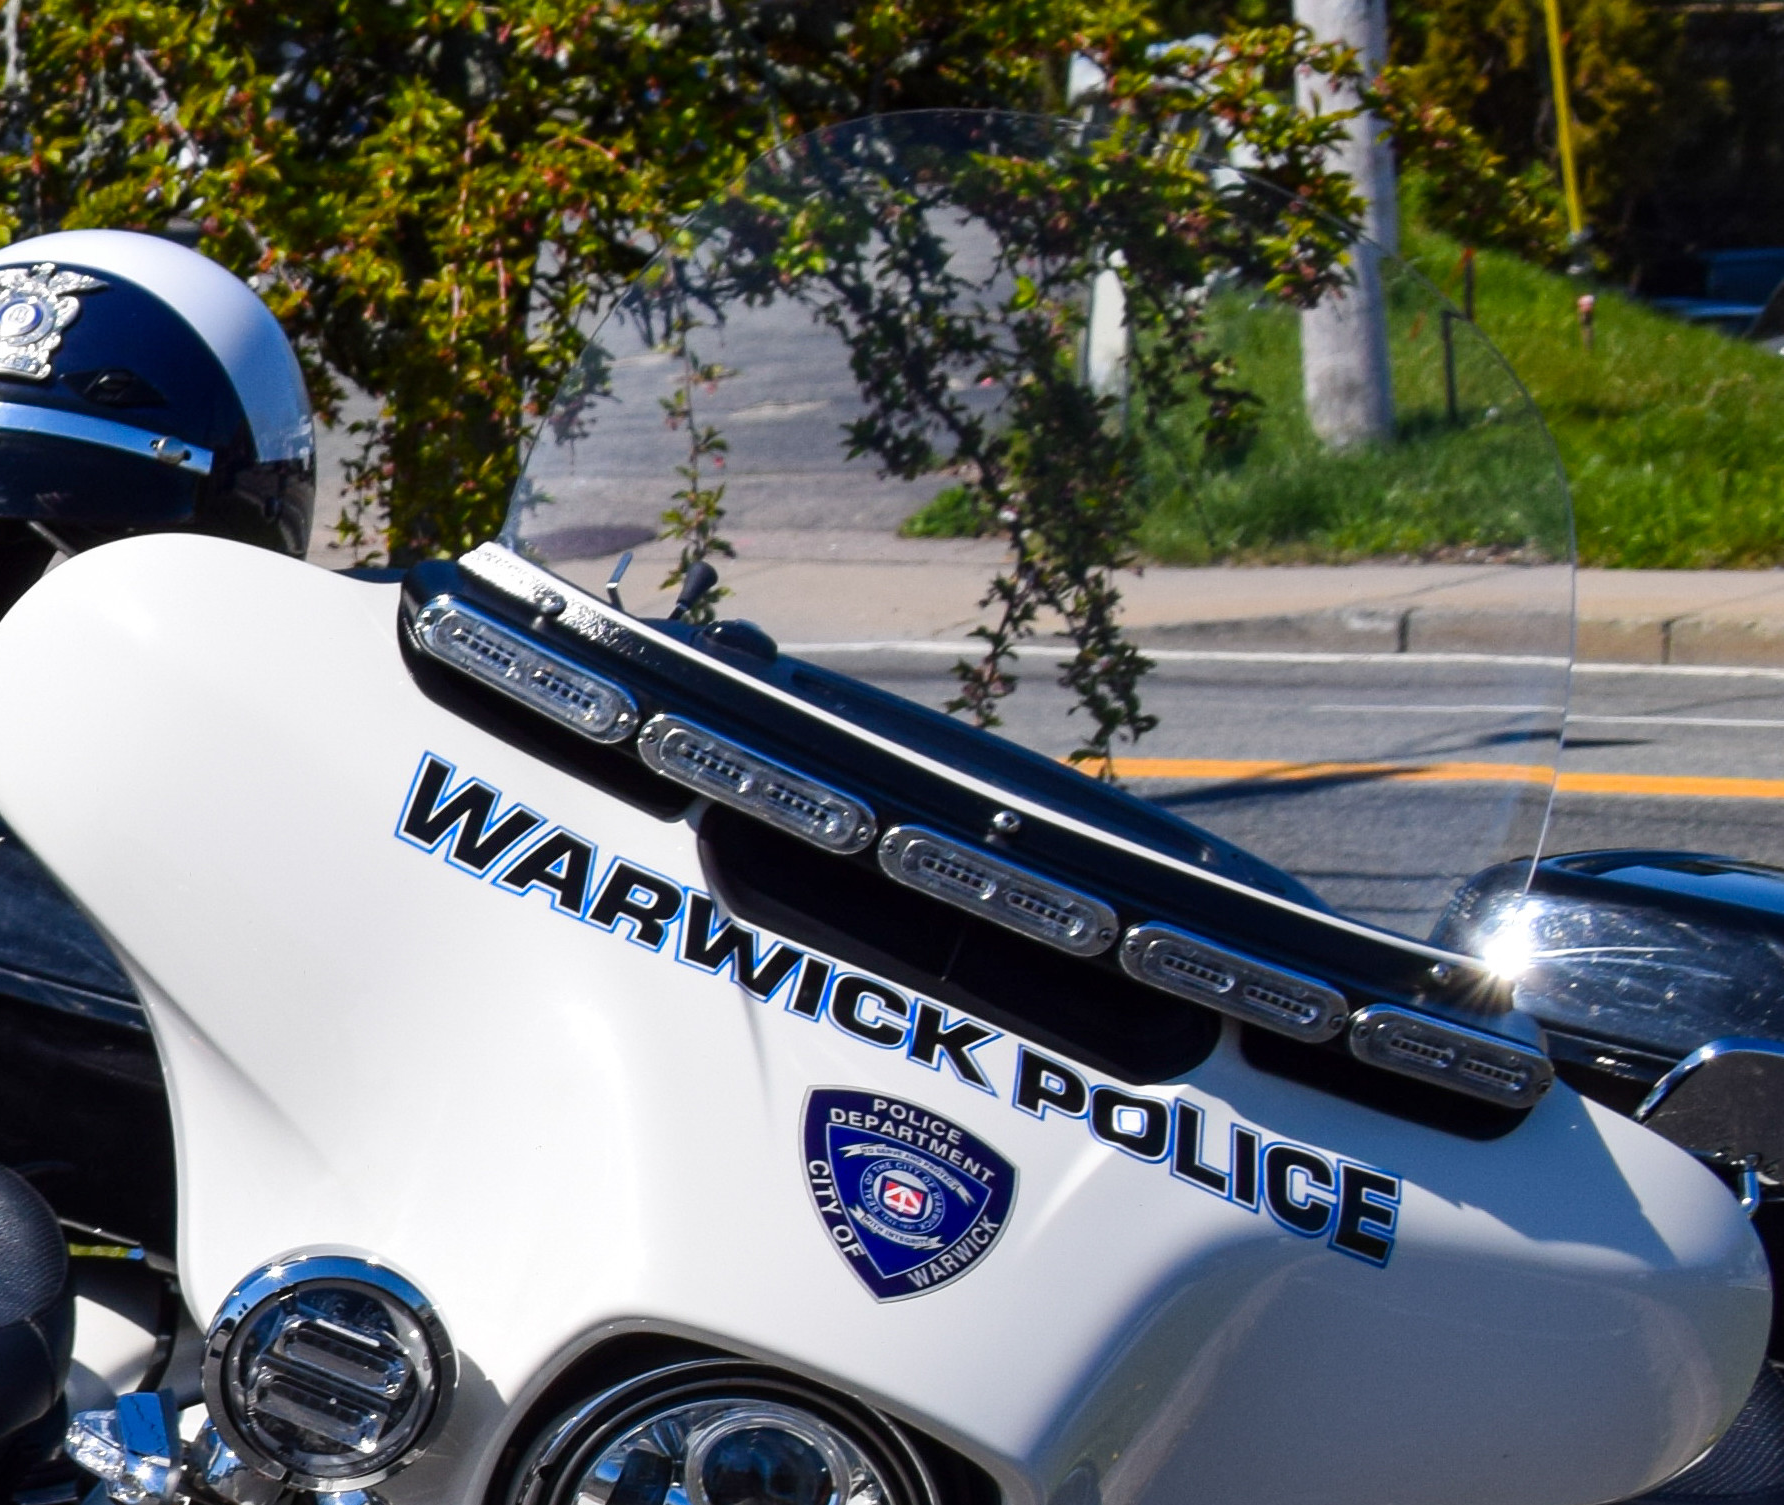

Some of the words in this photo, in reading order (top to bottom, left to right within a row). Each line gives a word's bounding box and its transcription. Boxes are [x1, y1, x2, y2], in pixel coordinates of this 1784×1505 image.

[395, 751, 1003, 1097] WARWICK
[1012, 1044, 1401, 1268] POLICE
[830, 1108, 995, 1182] DEPARTMENT
[873, 1098, 962, 1145] POLICE
[895, 1162, 921, 1175] CITY
[809, 1160, 842, 1215] CITY
[833, 1224, 866, 1260] OF
[906, 1215, 1000, 1288] WARWICK
